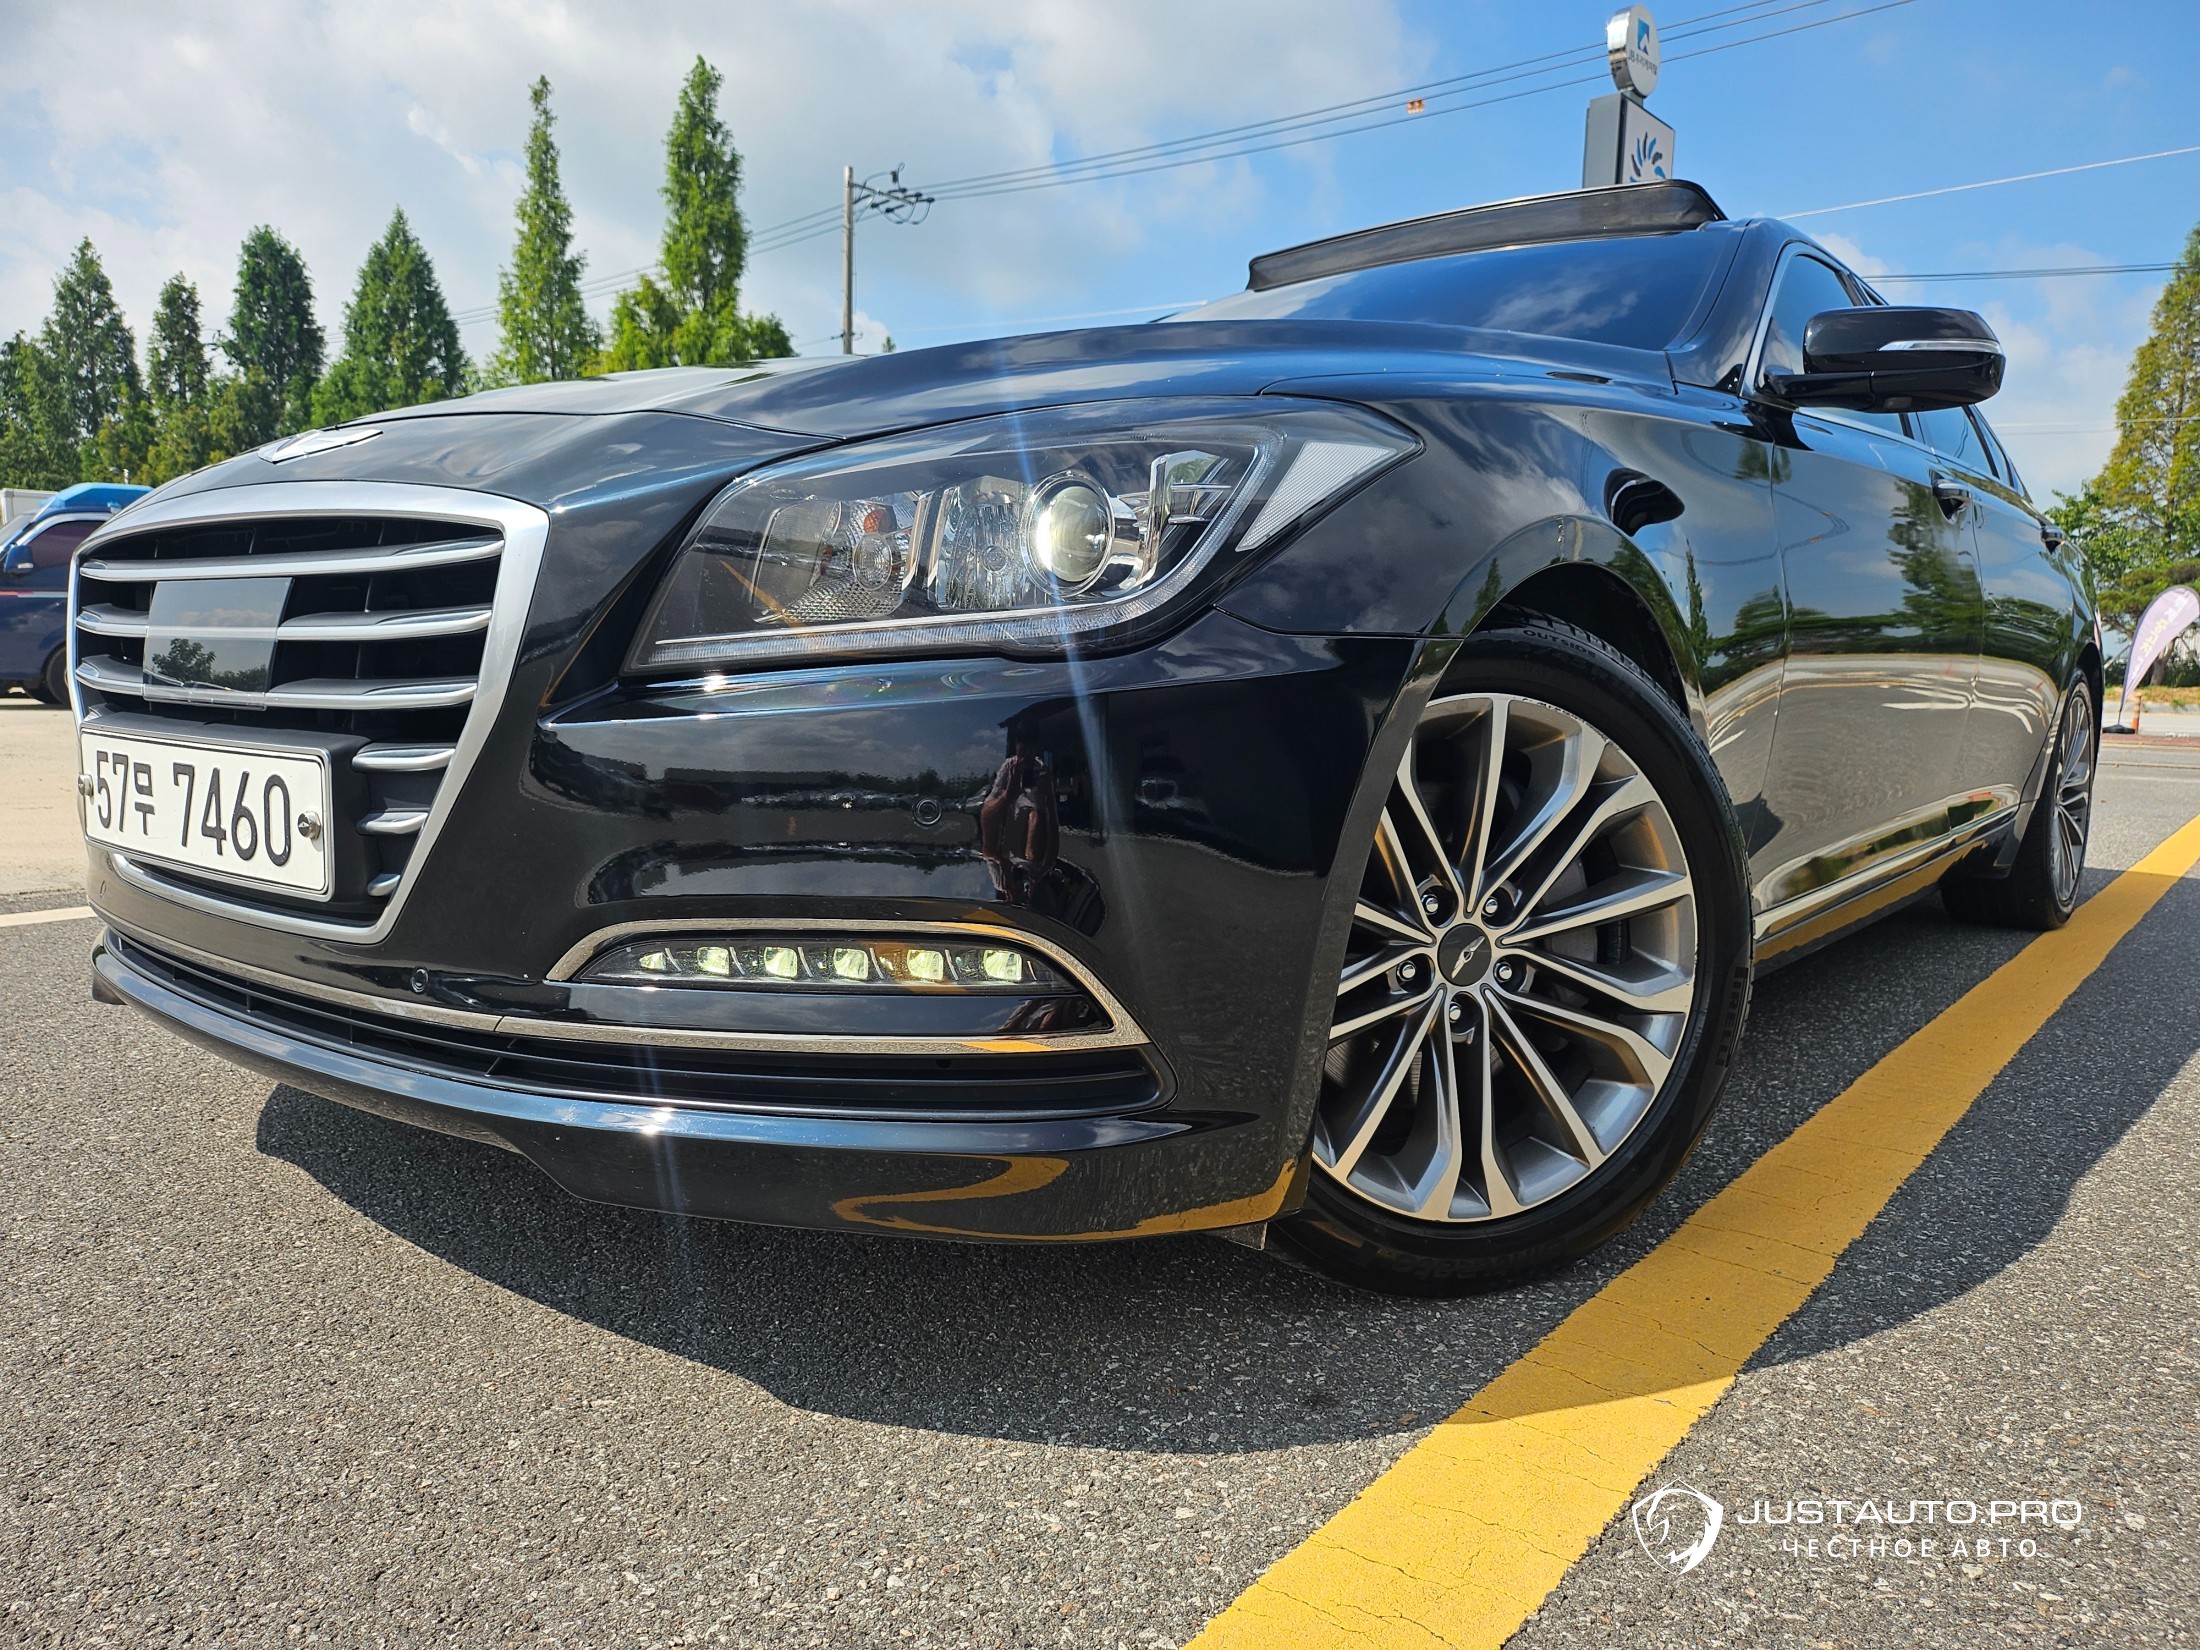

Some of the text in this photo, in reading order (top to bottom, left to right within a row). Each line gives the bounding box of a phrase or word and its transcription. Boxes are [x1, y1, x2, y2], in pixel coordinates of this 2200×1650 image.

[1522, 628, 1597, 658] OUTSIDE
[96, 750, 291, 867] 57무 7460
[1715, 966, 1749, 1067] PIRELLI
